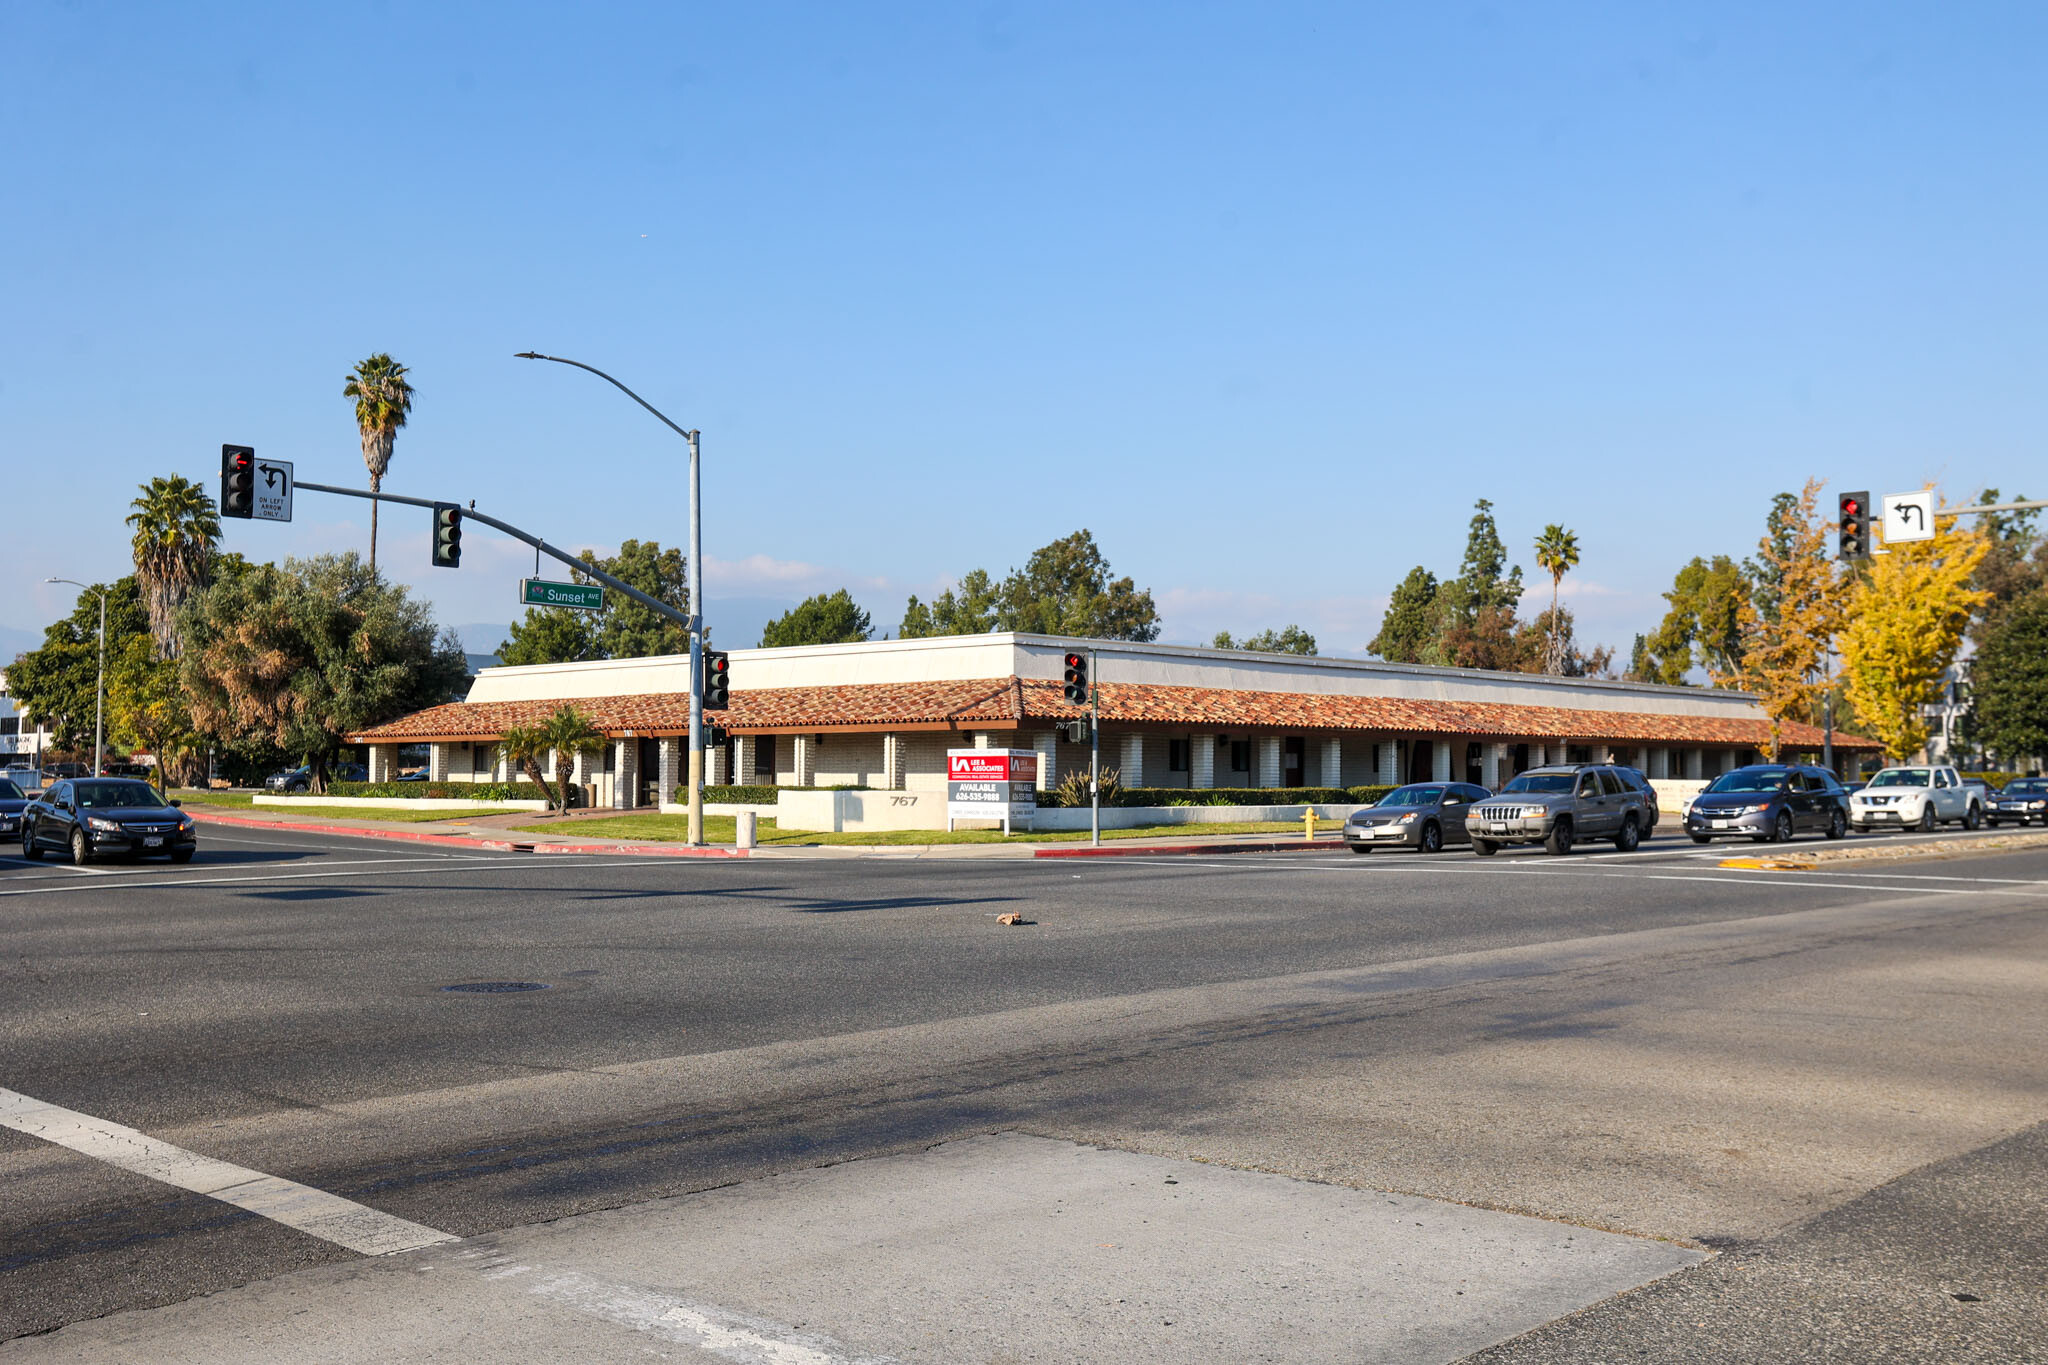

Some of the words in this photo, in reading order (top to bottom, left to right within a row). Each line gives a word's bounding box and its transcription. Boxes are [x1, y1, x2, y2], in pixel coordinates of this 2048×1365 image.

[548, 589, 585, 603] Sunset
[960, 783, 996, 791] AVAILABLE
[890, 796, 918, 806] 767
